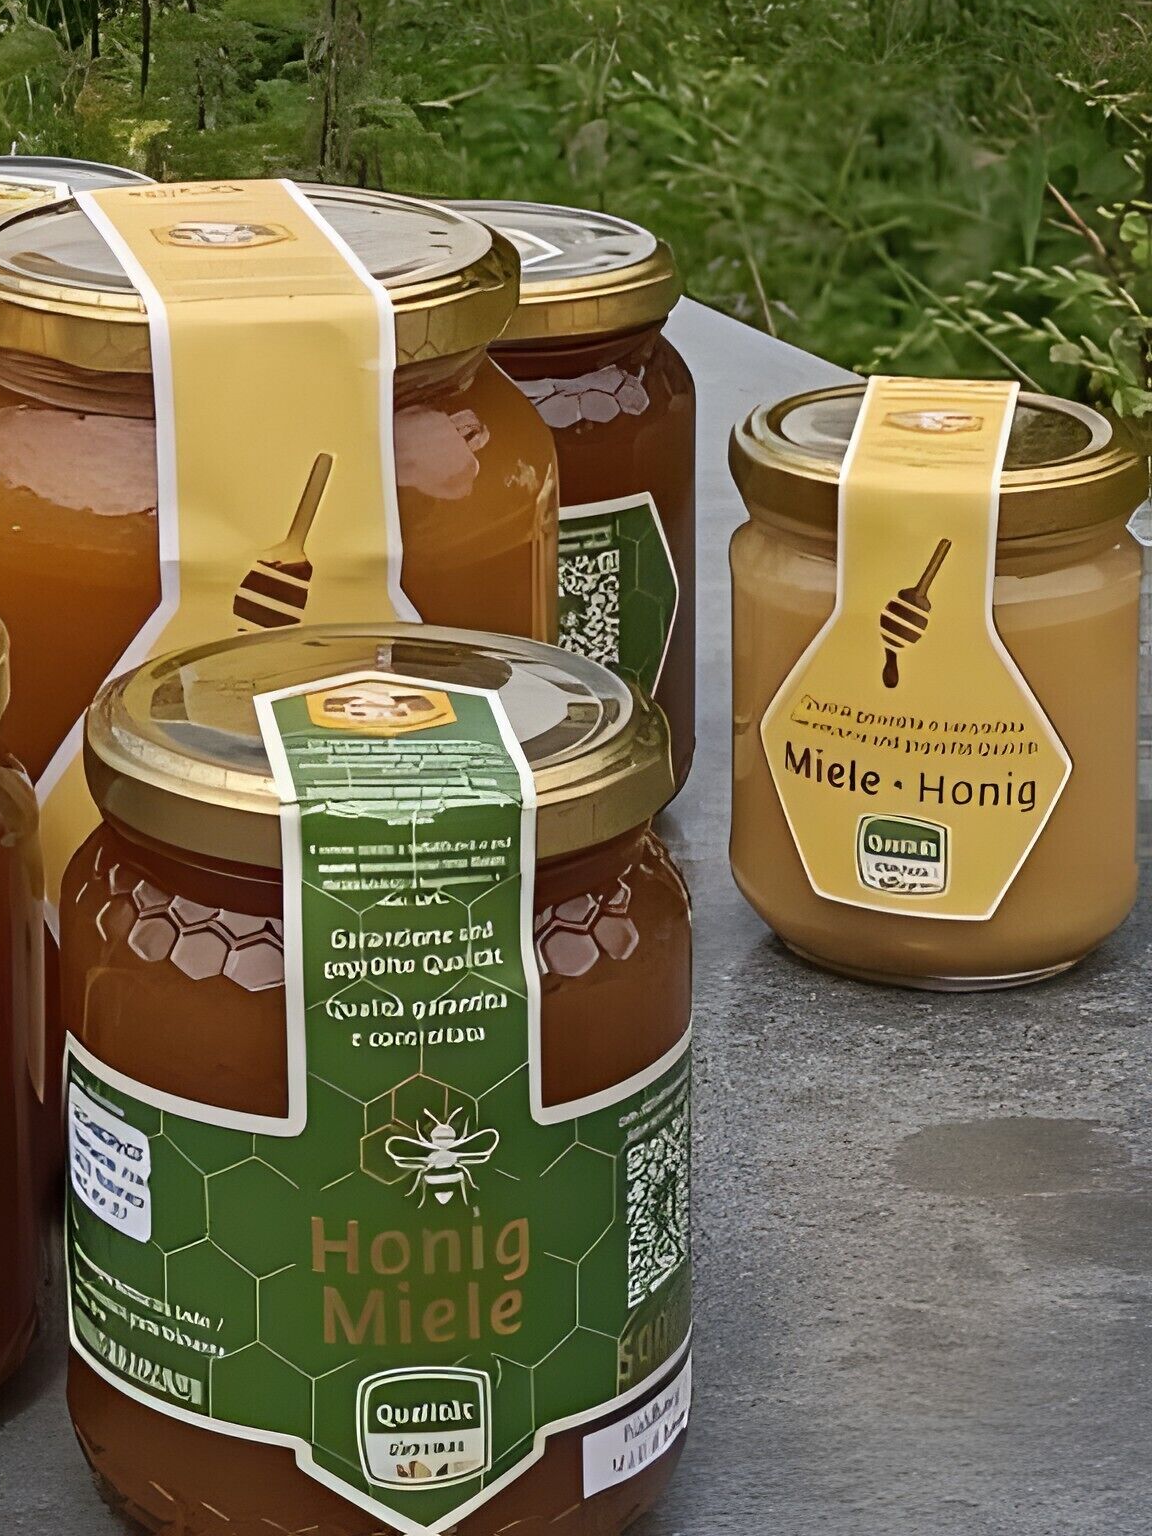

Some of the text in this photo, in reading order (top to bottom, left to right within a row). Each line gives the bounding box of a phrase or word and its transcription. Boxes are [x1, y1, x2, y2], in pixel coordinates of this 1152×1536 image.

[784, 740, 881, 796] Miele
[918, 771, 1037, 813] Honig
[310, 1208, 530, 1281] Honig
[322, 1280, 523, 1346] Miele
